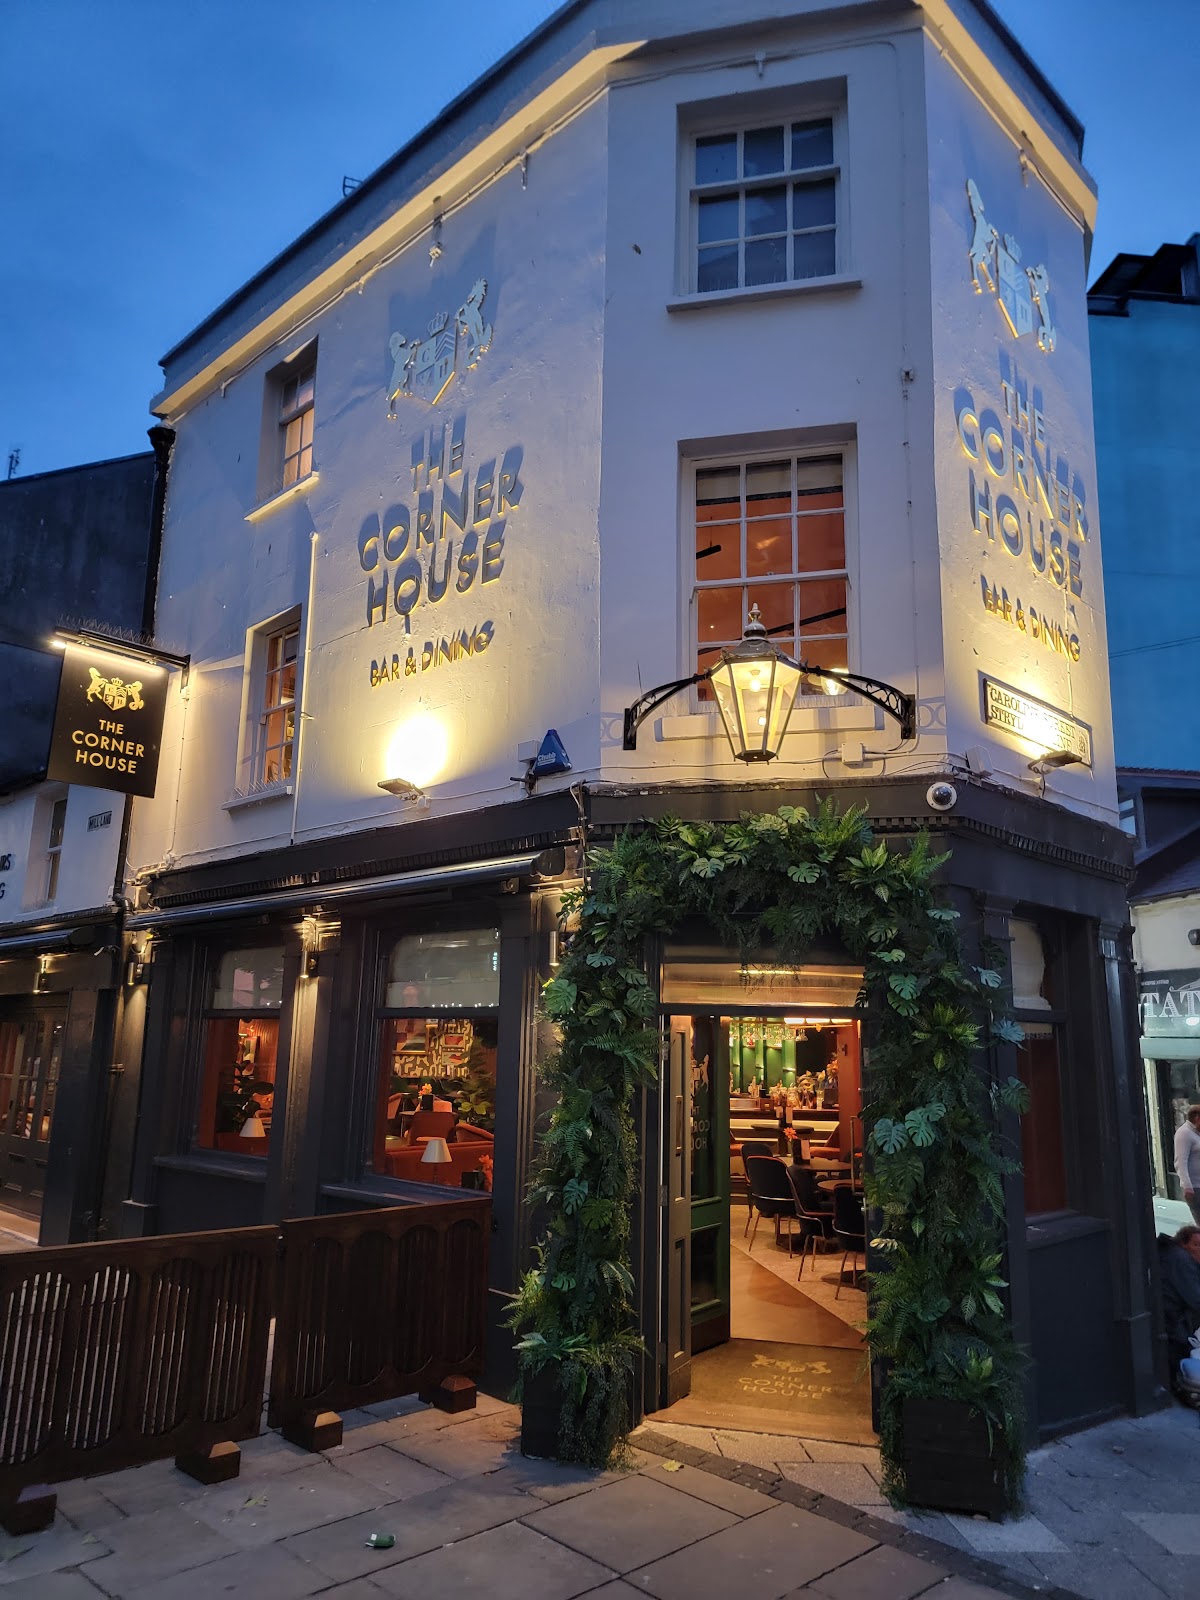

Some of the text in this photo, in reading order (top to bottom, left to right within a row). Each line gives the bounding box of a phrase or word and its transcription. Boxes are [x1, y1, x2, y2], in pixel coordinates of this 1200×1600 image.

[1001, 378, 1045, 450] THE
[410, 432, 465, 496] THE
[957, 405, 1087, 542] CORNER
[359, 464, 519, 573] CORNER
[973, 481, 1083, 599] HOUSE
[367, 534, 502, 628] HOUSE
[984, 587, 1081, 662] BAR & DINING
[370, 631, 489, 688] BAR & DINING
[71, 729, 146, 758] CORNER
[99, 719, 125, 735] THE
[538, 752, 556, 761] Chubb
[75, 749, 138, 774] HOUSE
[738, 1377, 832, 1393] CORNER
[743, 1385, 823, 1399] HOUSE
